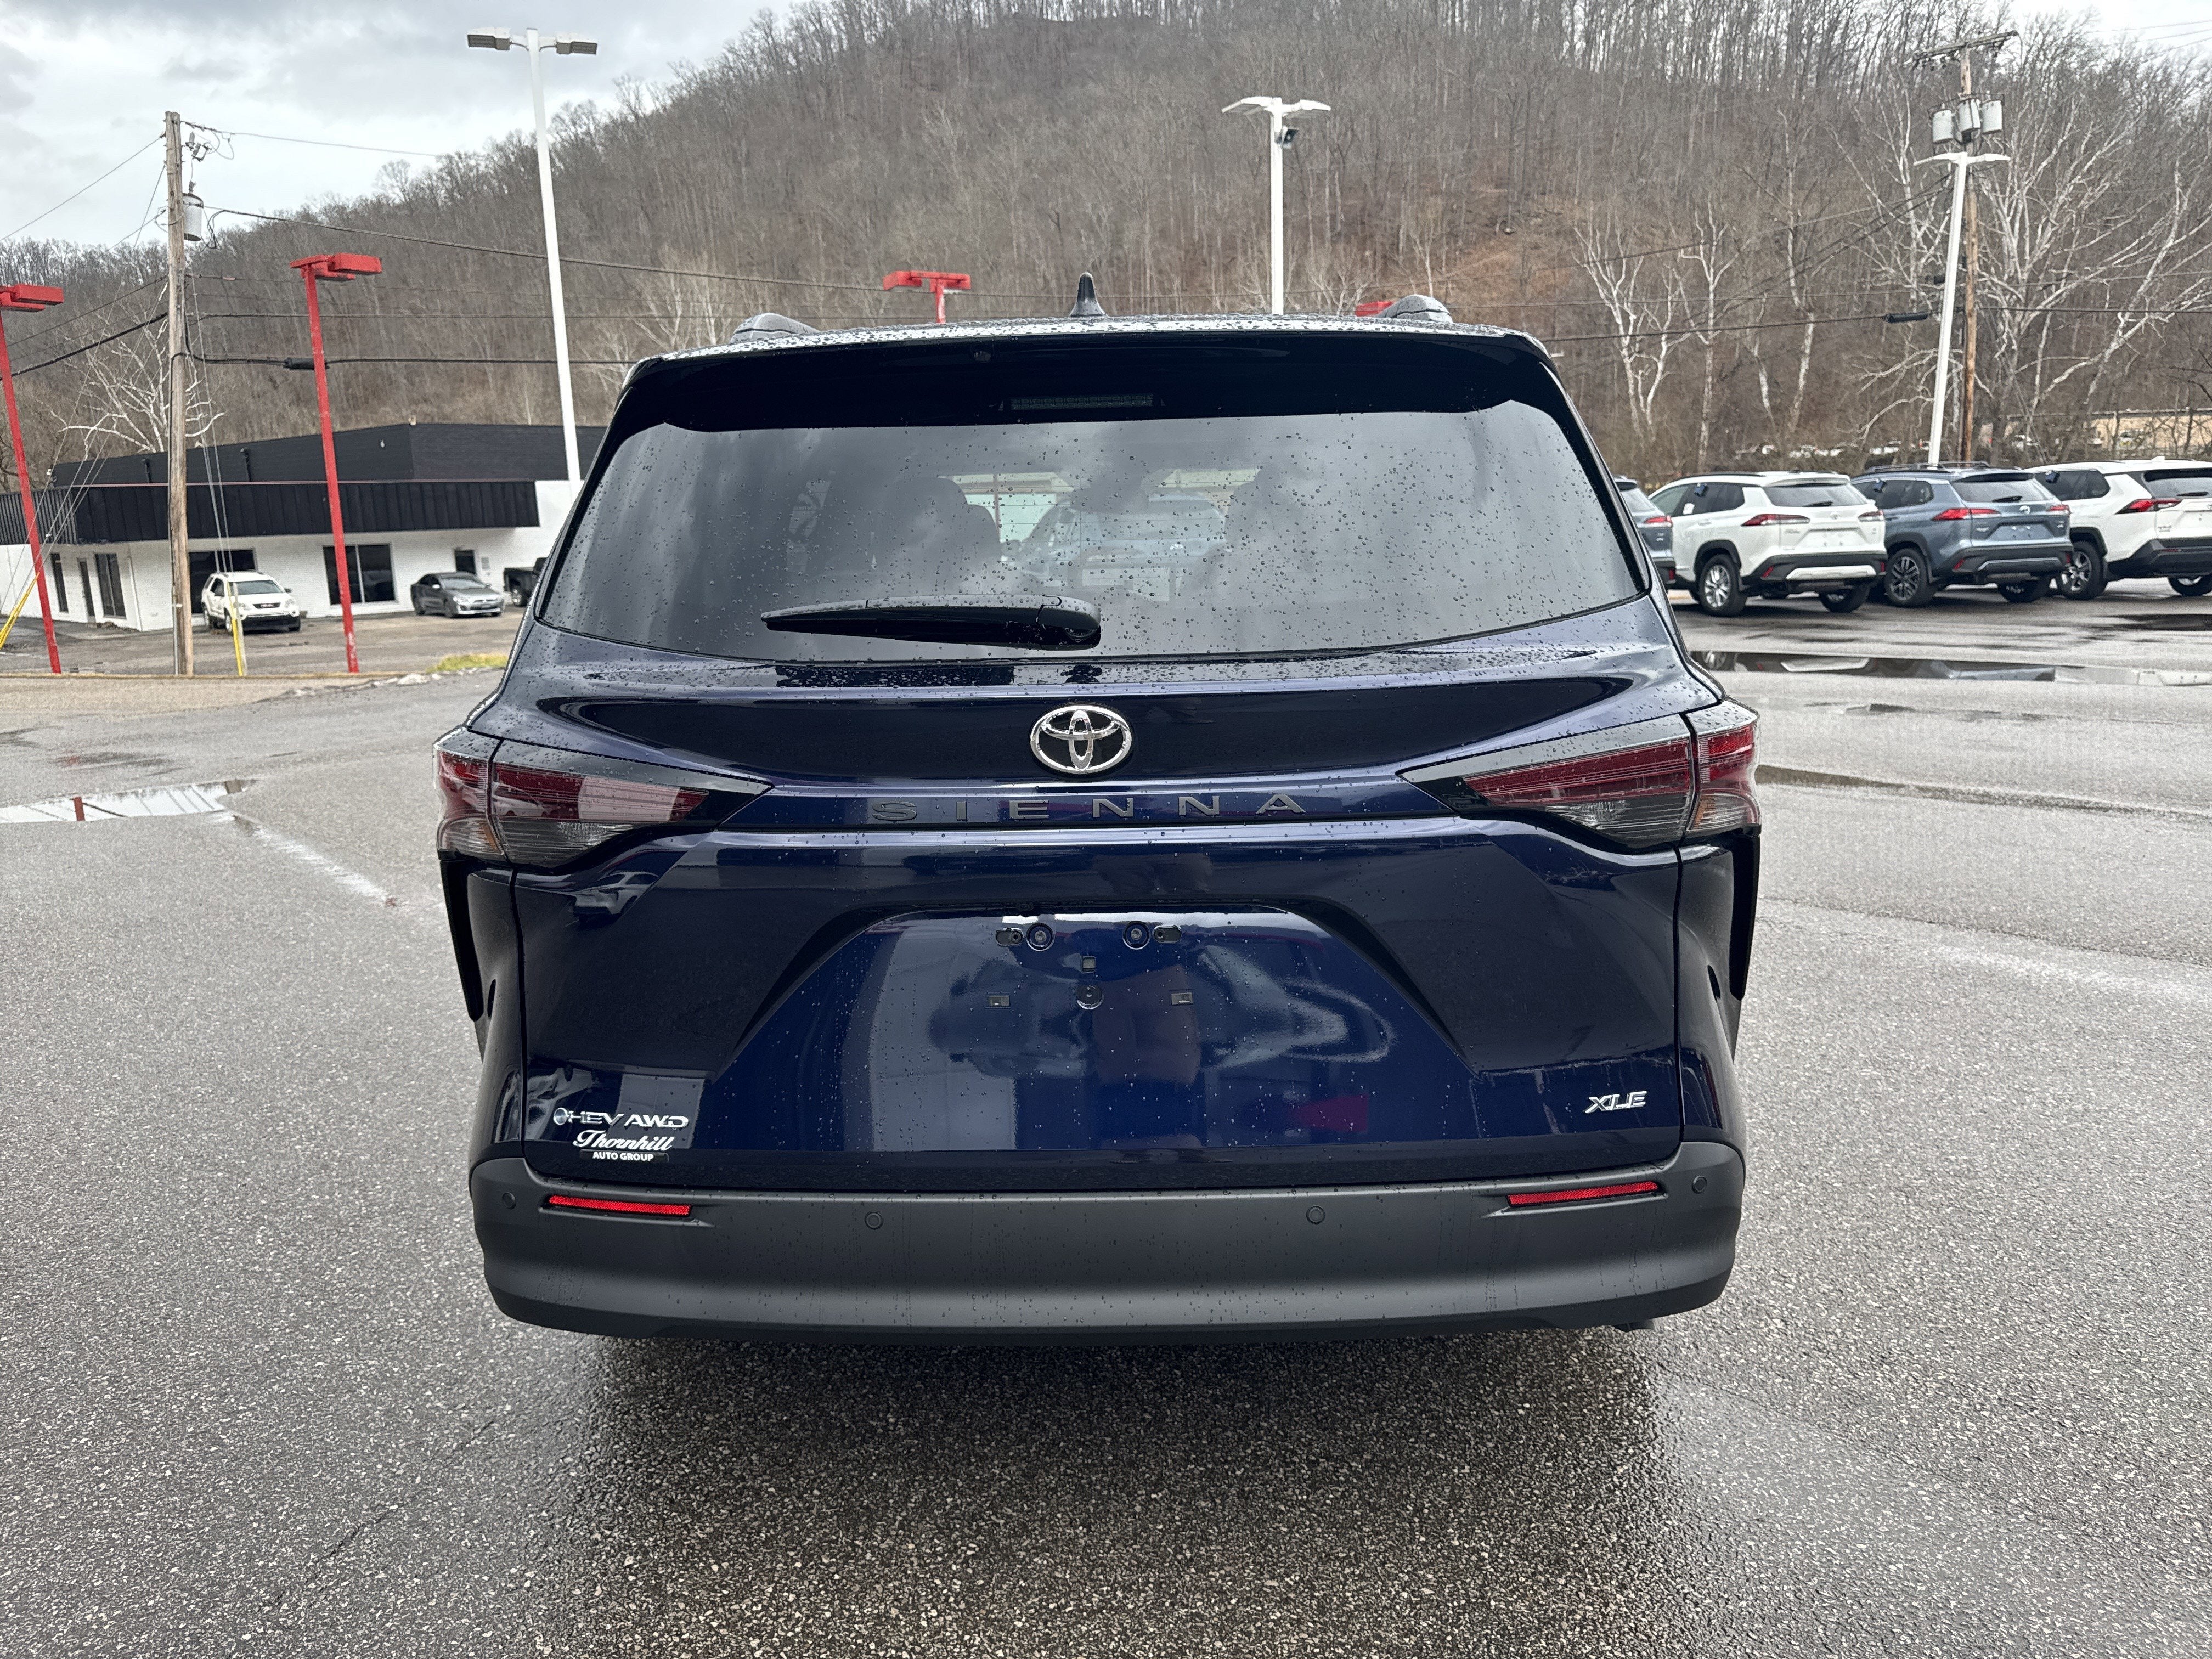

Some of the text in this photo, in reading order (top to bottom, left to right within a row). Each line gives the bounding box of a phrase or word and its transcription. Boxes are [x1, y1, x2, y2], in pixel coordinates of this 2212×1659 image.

[872, 793, 1307, 821] SIENNA
[1584, 1091, 1647, 1114] XLE
[624, 1114, 689, 1128] AWD
[573, 1129, 675, 1151] Thornhill
[592, 1151, 654, 1162] AUTO GROUP
